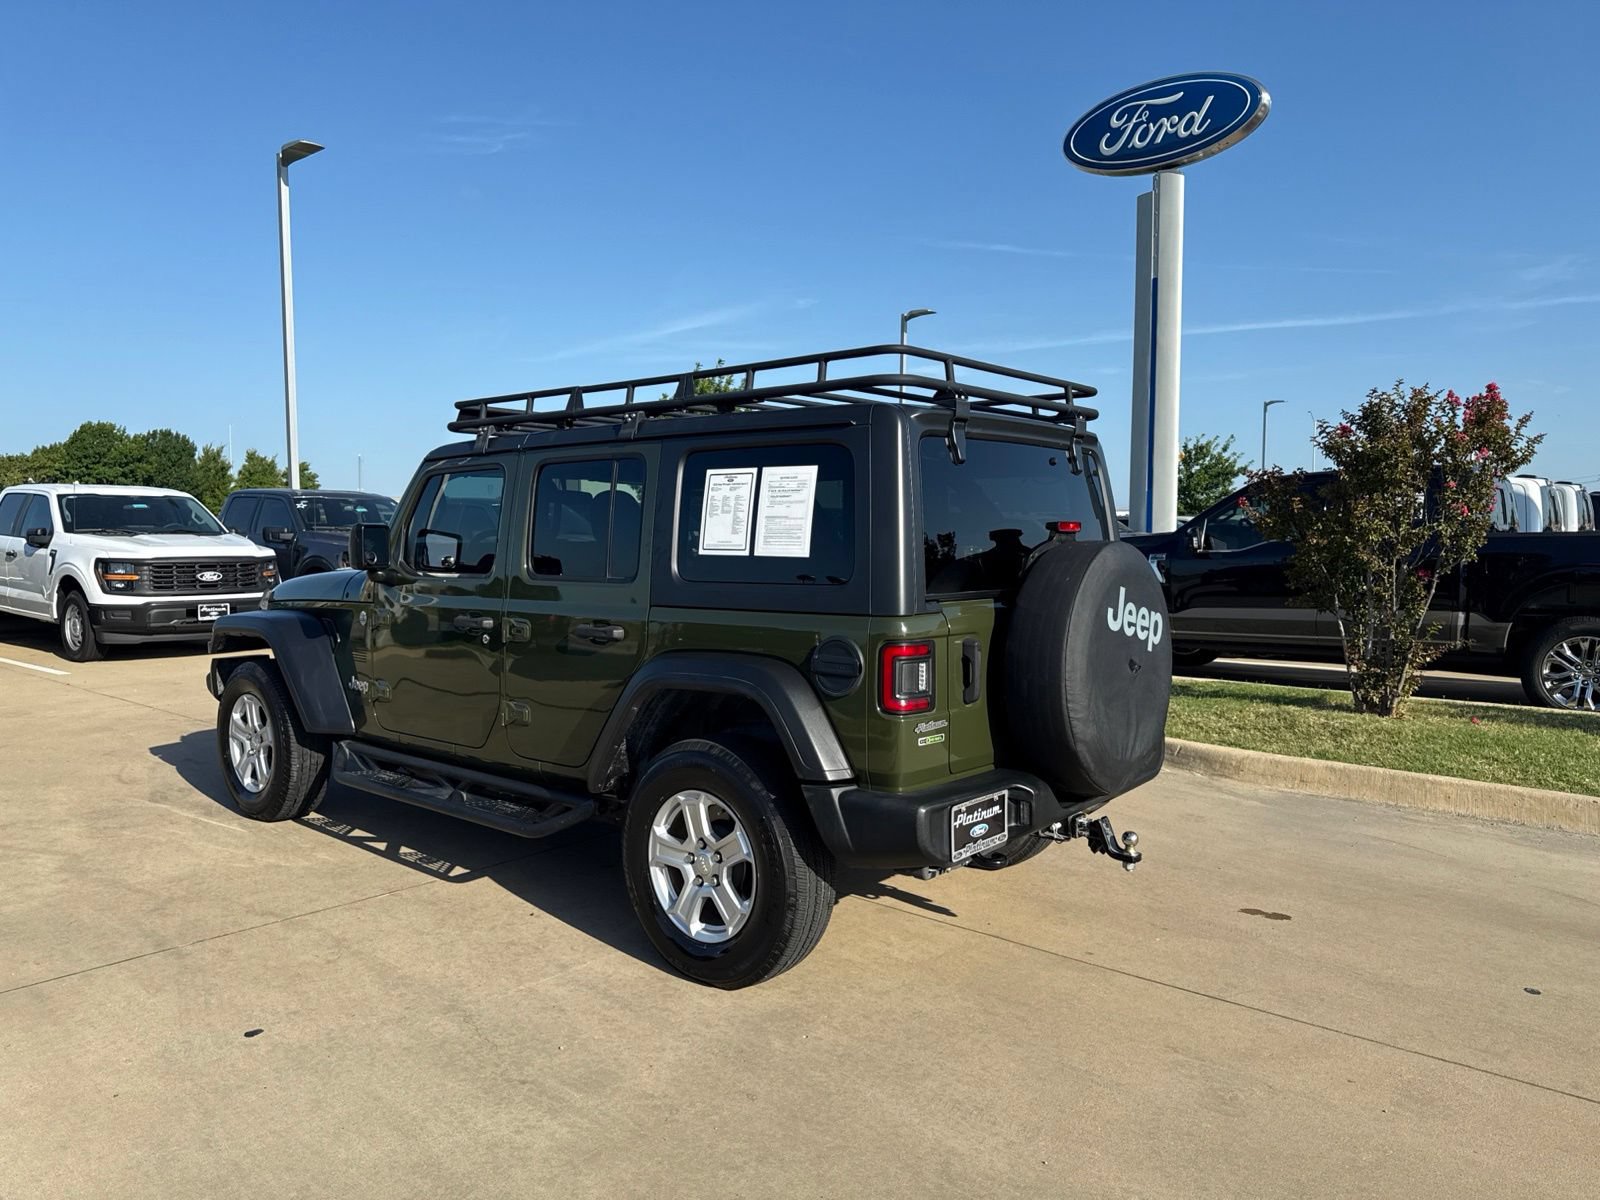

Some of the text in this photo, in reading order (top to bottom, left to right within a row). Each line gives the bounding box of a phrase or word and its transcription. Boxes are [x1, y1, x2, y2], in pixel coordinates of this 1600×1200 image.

[1099, 91, 1215, 156] Ford
[1107, 586, 1163, 652] Jeep
[348, 675, 369, 695] Jeep
[953, 804, 1003, 828] Platinum
